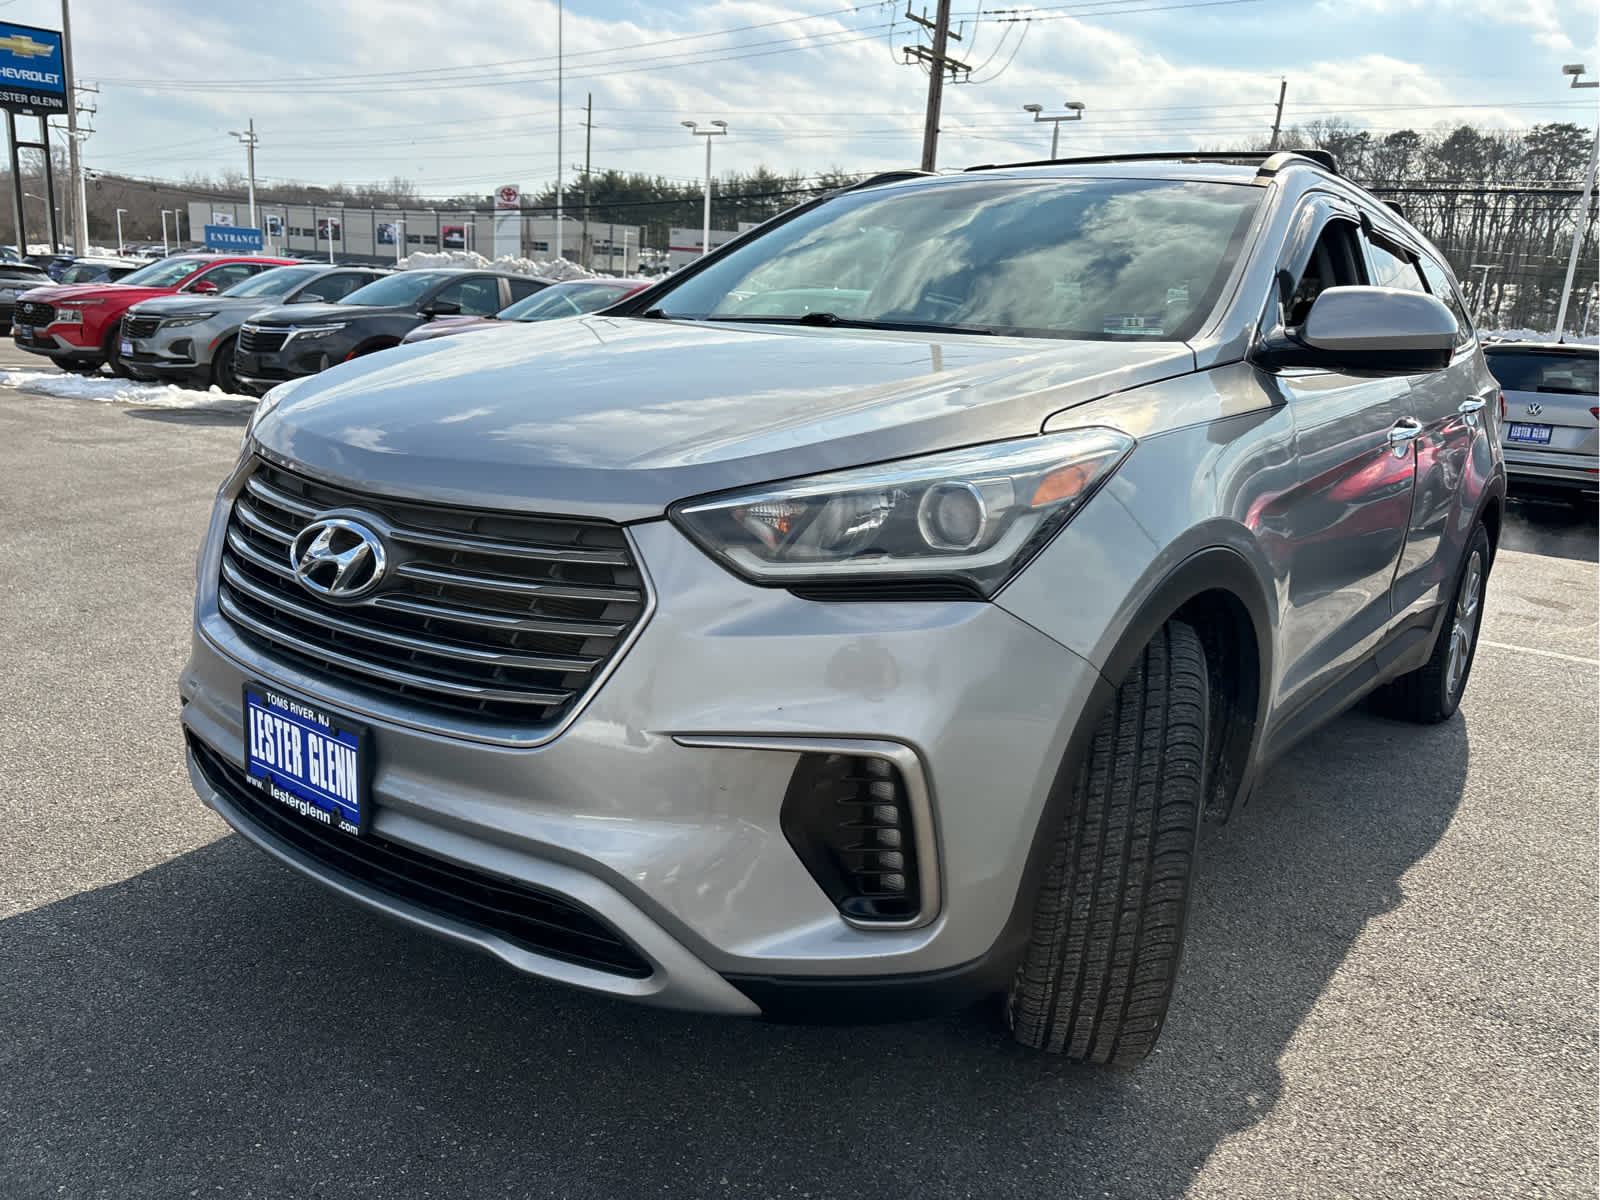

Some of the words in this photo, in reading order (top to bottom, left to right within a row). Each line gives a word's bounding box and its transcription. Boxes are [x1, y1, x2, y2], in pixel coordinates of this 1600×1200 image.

[0, 67, 59, 84] HEVROLET
[30, 95, 63, 107] GLENN
[210, 232, 260, 244] ENTRANCE
[1511, 425, 1531, 438] LESTER
[266, 692, 289, 711] TOMS
[318, 713, 330, 728] NJ
[249, 707, 303, 779] LESTER
[307, 732, 358, 805] GLENN
[270, 783, 331, 825] lesterglenn
